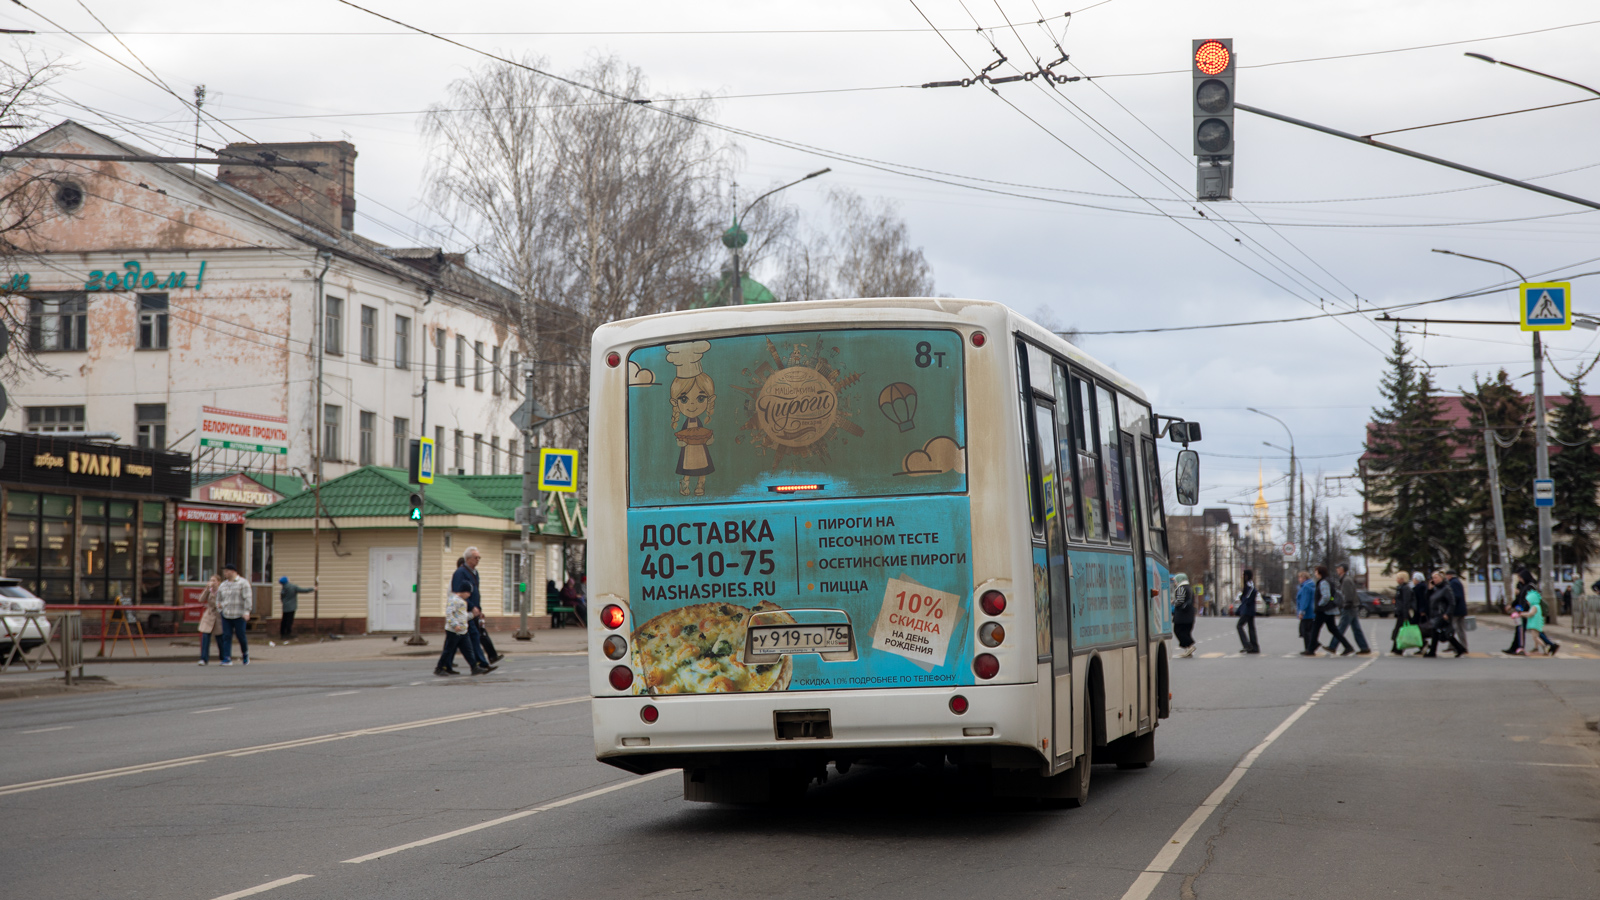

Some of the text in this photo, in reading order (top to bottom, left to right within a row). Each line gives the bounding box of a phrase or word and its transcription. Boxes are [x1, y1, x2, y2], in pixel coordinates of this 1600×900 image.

[84, 260, 207, 291] годом!
[202, 420, 288, 441] БЕЛОРУССКИЕ ПРОДУКТЫ
[68, 451, 121, 478] БУЛКИ
[209, 486, 273, 505] ПАРИКМАХЕРСКАЯ
[187, 509, 219, 522] БЕЛОРУССКИЕ
[818, 515, 895, 530] ПИРОГИ НА
[640, 519, 775, 552] ДОСТАВКА
[818, 532, 939, 548] ПЕСОЧНОМ ТЕСТЕ
[641, 549, 776, 580] 40-10-75
[818, 552, 967, 569] ОСЕТИНСКИЕ ПИРОГИ
[642, 580, 776, 601] MASHASPIES.RU
[820, 580, 869, 594] ПИЦЦА
[896, 591, 944, 619] 10%
[889, 613, 941, 635] СКИДКА
[827, 628, 843, 641] 76
[892, 630, 930, 645] НА ДЕНЬ
[884, 638, 934, 656] РОЖДЕНИЯ
[800, 673, 957, 687] СКИДКА 10% ПОДРОБНЕЕ ПО ТЕЛЕФОНУ
